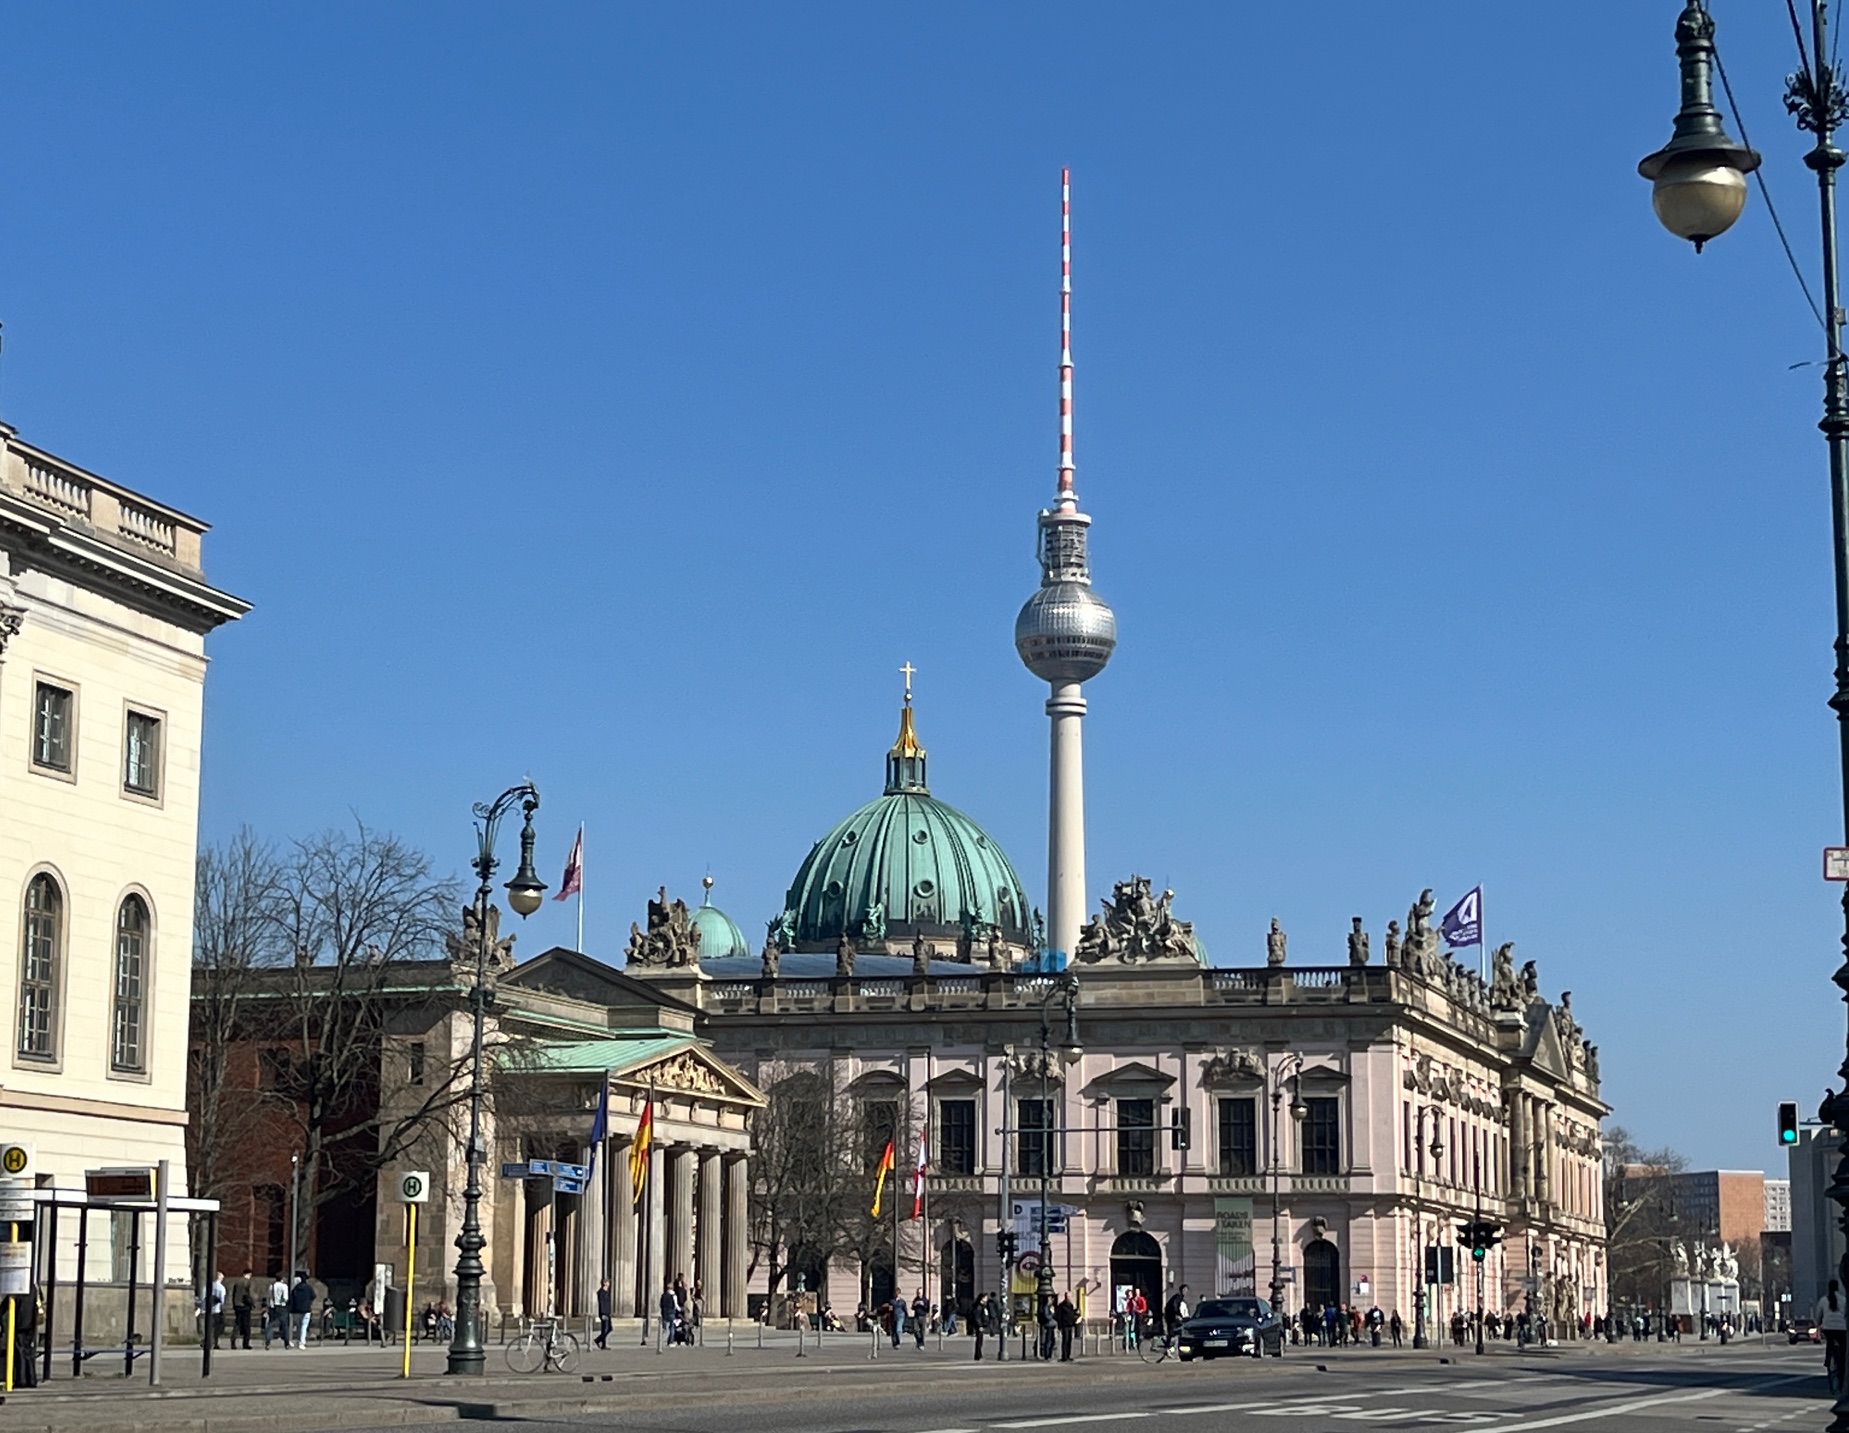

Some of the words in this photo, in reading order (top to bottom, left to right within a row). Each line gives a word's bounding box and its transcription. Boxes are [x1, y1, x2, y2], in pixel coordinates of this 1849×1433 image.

[9, 1153, 20, 1168] H
[407, 1181, 417, 1193] H
[1013, 1204, 1023, 1215] D
